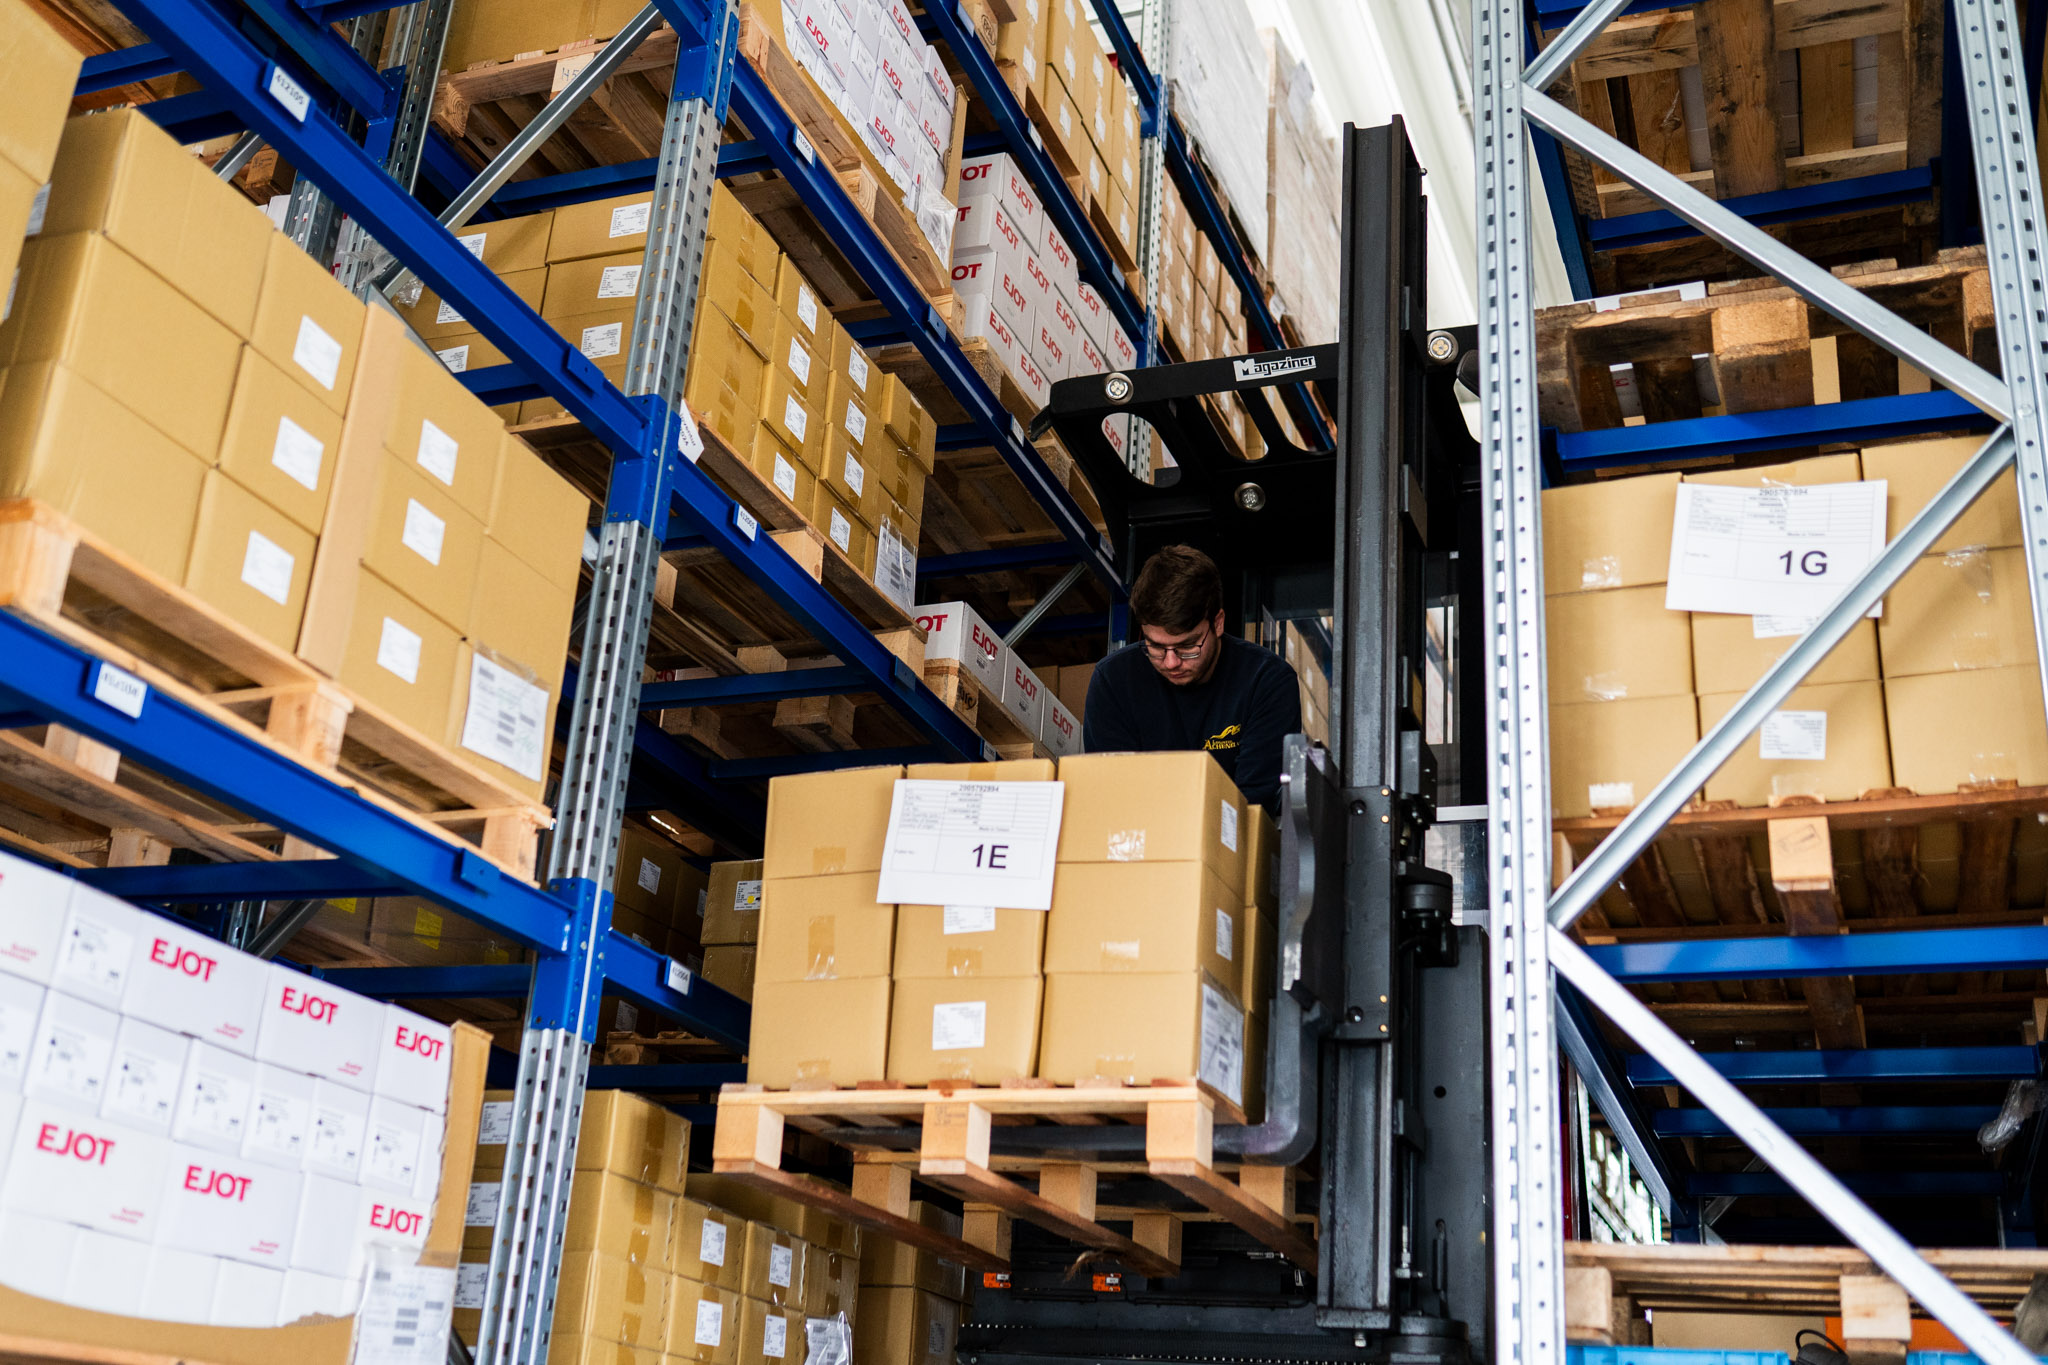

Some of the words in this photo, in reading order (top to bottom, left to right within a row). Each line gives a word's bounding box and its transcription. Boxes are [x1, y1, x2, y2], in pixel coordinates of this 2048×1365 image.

[806, 16, 829, 51] EJOT
[892, 5, 911, 37] EJOT
[883, 59, 902, 91] EJOT
[934, 67, 948, 96] EJOT
[875, 117, 895, 147] EJOT
[924, 120, 941, 150] EJOT
[1011, 176, 1034, 215] EJOT
[995, 211, 1019, 250] EJOT
[1048, 231, 1069, 267] EJOT
[1027, 256, 1050, 294] EJOT
[1003, 273, 1026, 312] EJOT
[1078, 284, 1100, 316] EJOT
[989, 311, 1012, 349] EJOT
[1056, 300, 1076, 336] EJOT
[1041, 328, 1062, 364] EJOT
[1083, 340, 1102, 374] EJOT
[1114, 328, 1132, 362] EJOT
[1020, 353, 1042, 392] EJOT
[1233, 356, 1316, 381] Magaziner
[1104, 419, 1123, 451] EJOT
[1779, 550, 1828, 576] 1G
[972, 624, 998, 660] EJOT
[1015, 667, 1037, 701] EJOT
[1053, 707, 1073, 739] EJOT
[972, 844, 1009, 869] 1E
[151, 939, 216, 981] EJOT
[281, 987, 338, 1023] EJOT
[396, 1026, 444, 1060] EJOT
[37, 1124, 115, 1164] EJOT
[184, 1165, 251, 1201] EJOT
[370, 1204, 422, 1235] EJOT
